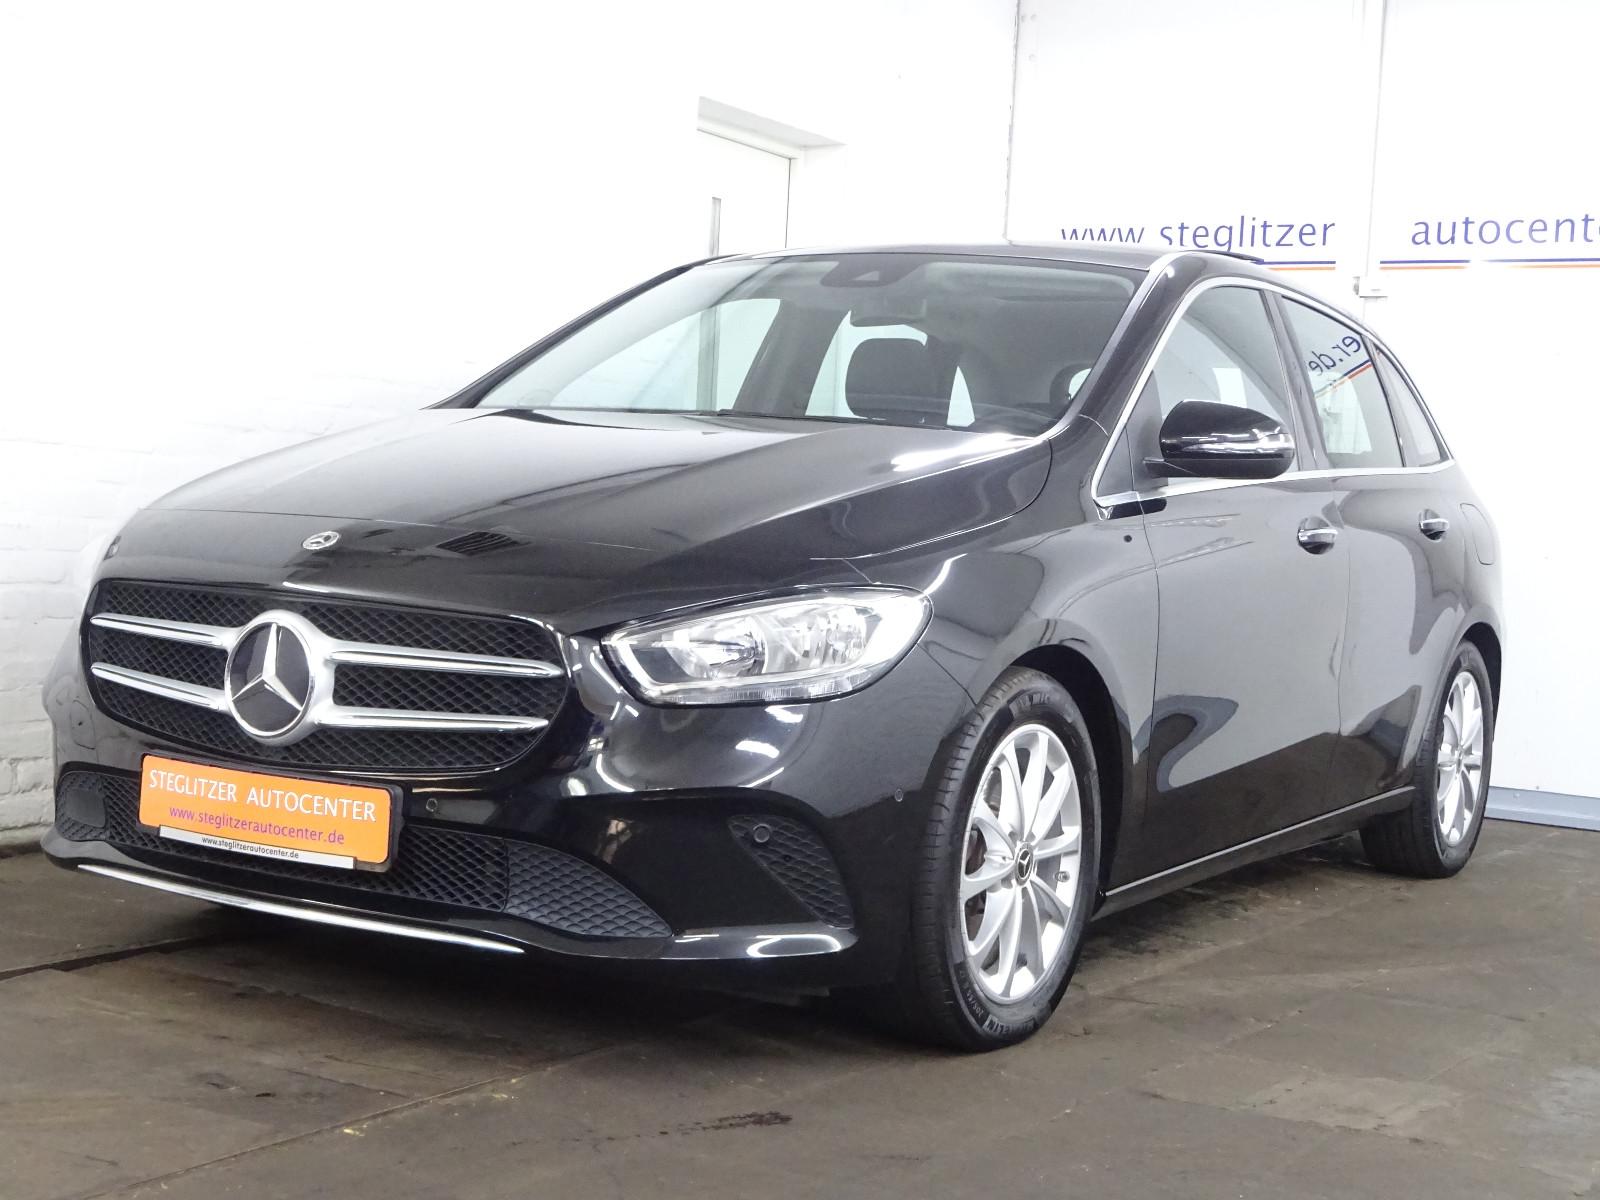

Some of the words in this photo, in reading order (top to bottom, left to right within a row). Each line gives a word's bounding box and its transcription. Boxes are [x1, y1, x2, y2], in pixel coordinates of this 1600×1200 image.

[1160, 215, 1336, 251] steglitzer
[1411, 214, 1600, 246] autocent
[149, 769, 238, 803] STEGLITZER
[246, 786, 377, 823] AUTOCENTER
[169, 805, 346, 846] www.steglitzerautocenter.de
[202, 836, 300, 859] www.steglitzerautocenter.de
